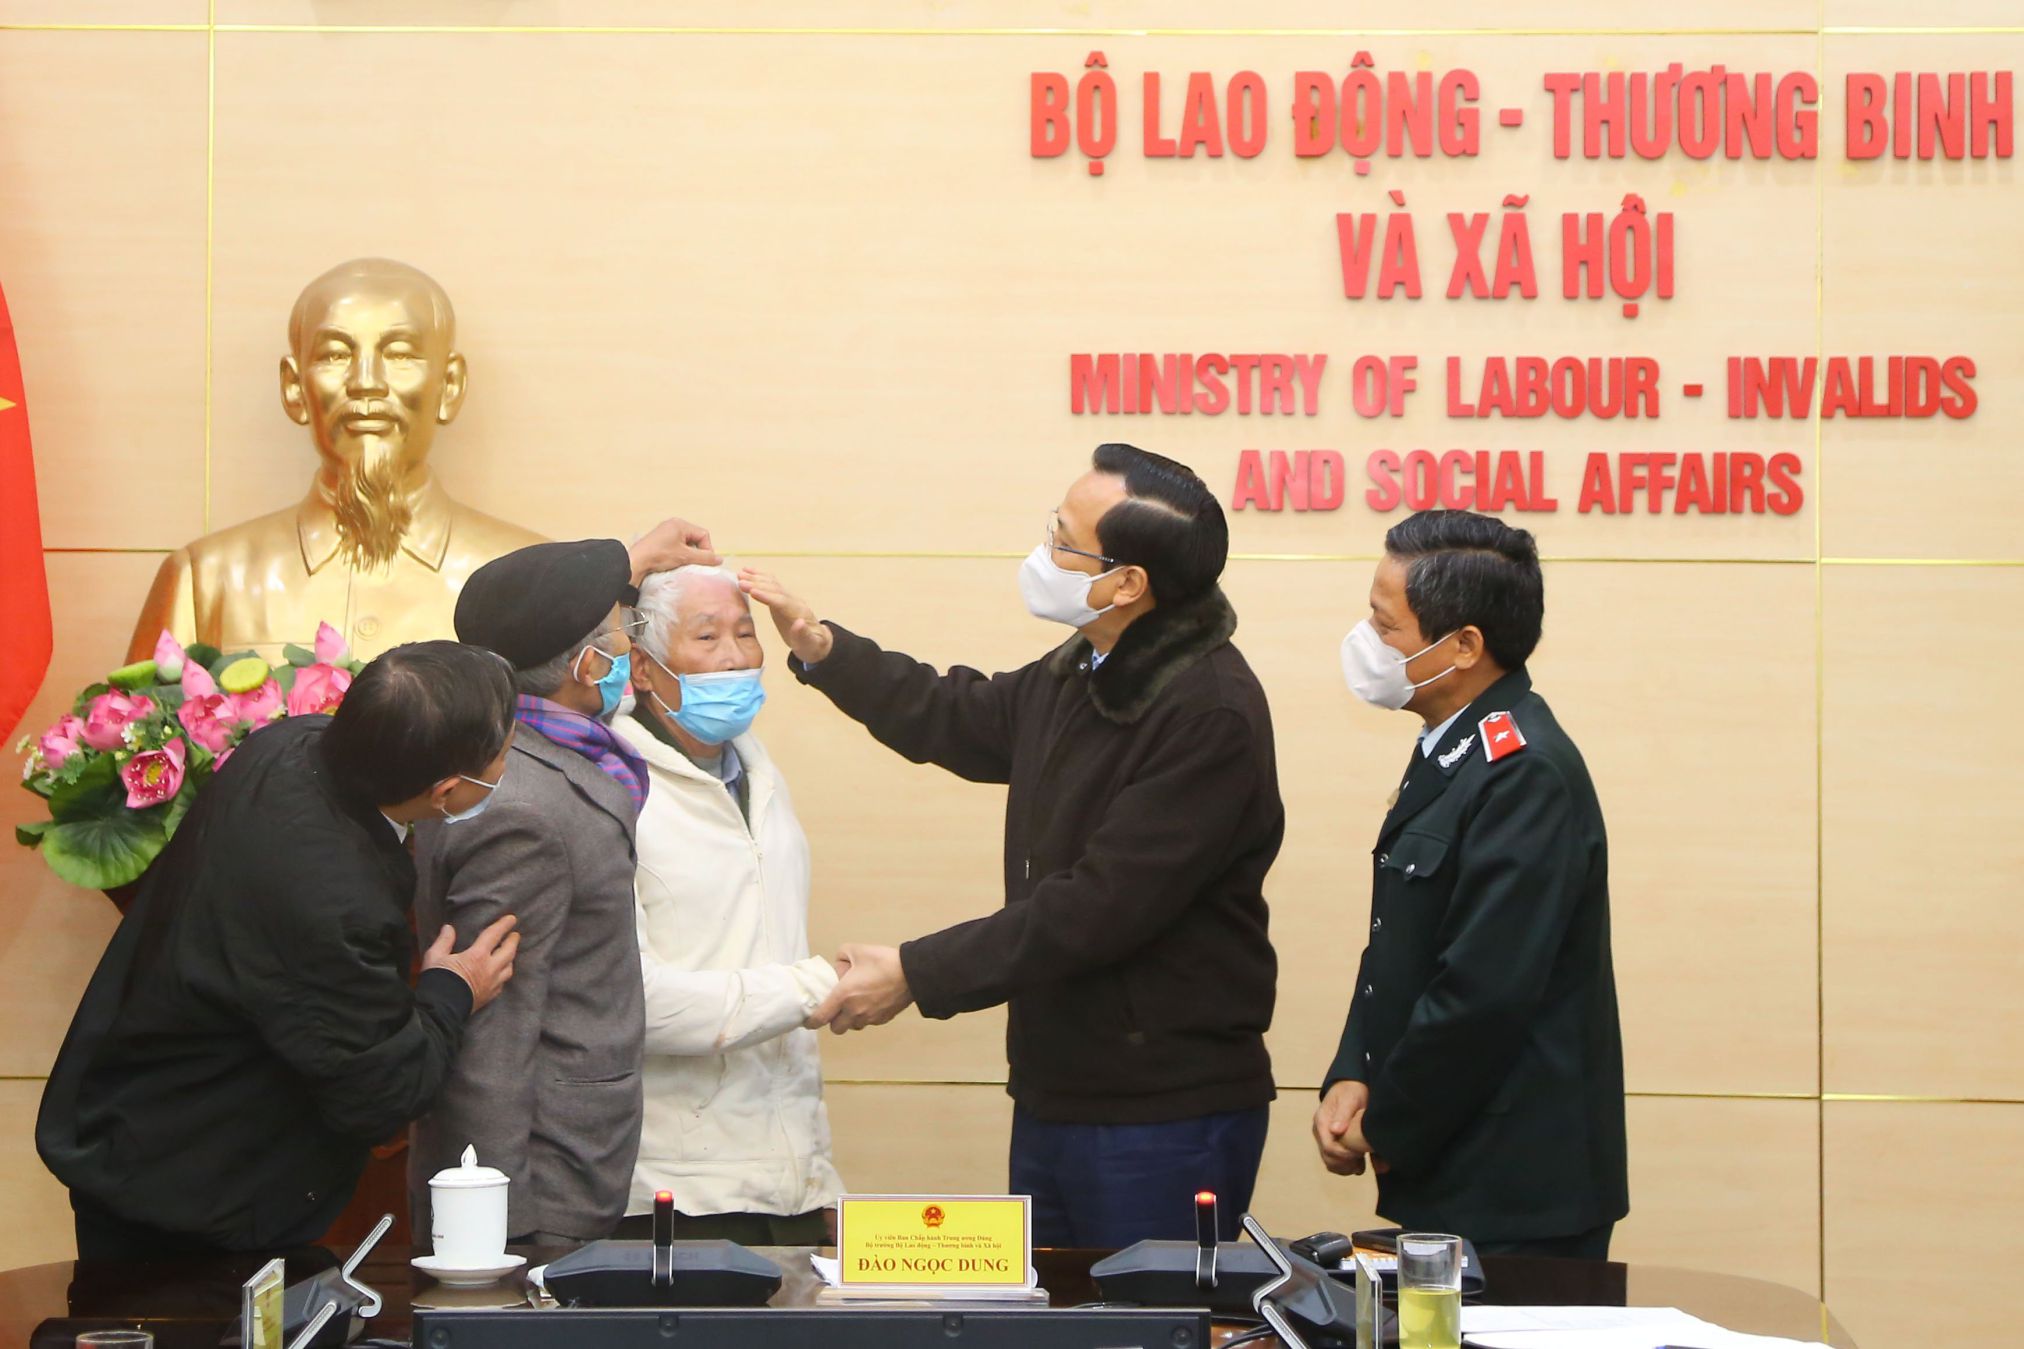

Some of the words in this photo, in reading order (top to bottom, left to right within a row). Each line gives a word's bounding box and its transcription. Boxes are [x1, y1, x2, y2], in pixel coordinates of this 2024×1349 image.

[1030, 51, 1118, 176] BỘ
[1143, 71, 1268, 160] LAO
[1291, 51, 1481, 176] ĐỘNG
[1498, 108, 1525, 127] -
[1544, 63, 1819, 161] THƯƠNG
[1845, 71, 2015, 160] BINH
[1336, 190, 1423, 300] VÀ
[1447, 193, 1539, 300] XÃ
[1562, 193, 1676, 319] HỘI
[1070, 353, 1328, 417] MINISTRY
[1352, 355, 1419, 418] OF
[1446, 356, 1661, 420] LABOUR
[1682, 383, 1704, 397] -
[1727, 355, 1979, 420] INVALIDS
[1231, 450, 1346, 512] AND
[1365, 450, 1560, 513] SOCIAL
[1577, 452, 1804, 517] AFFAIRS
[858, 1254, 896, 1272] ĐÀO
[901, 1258, 953, 1275] NGỌC
[958, 1258, 1009, 1272] DUNG
